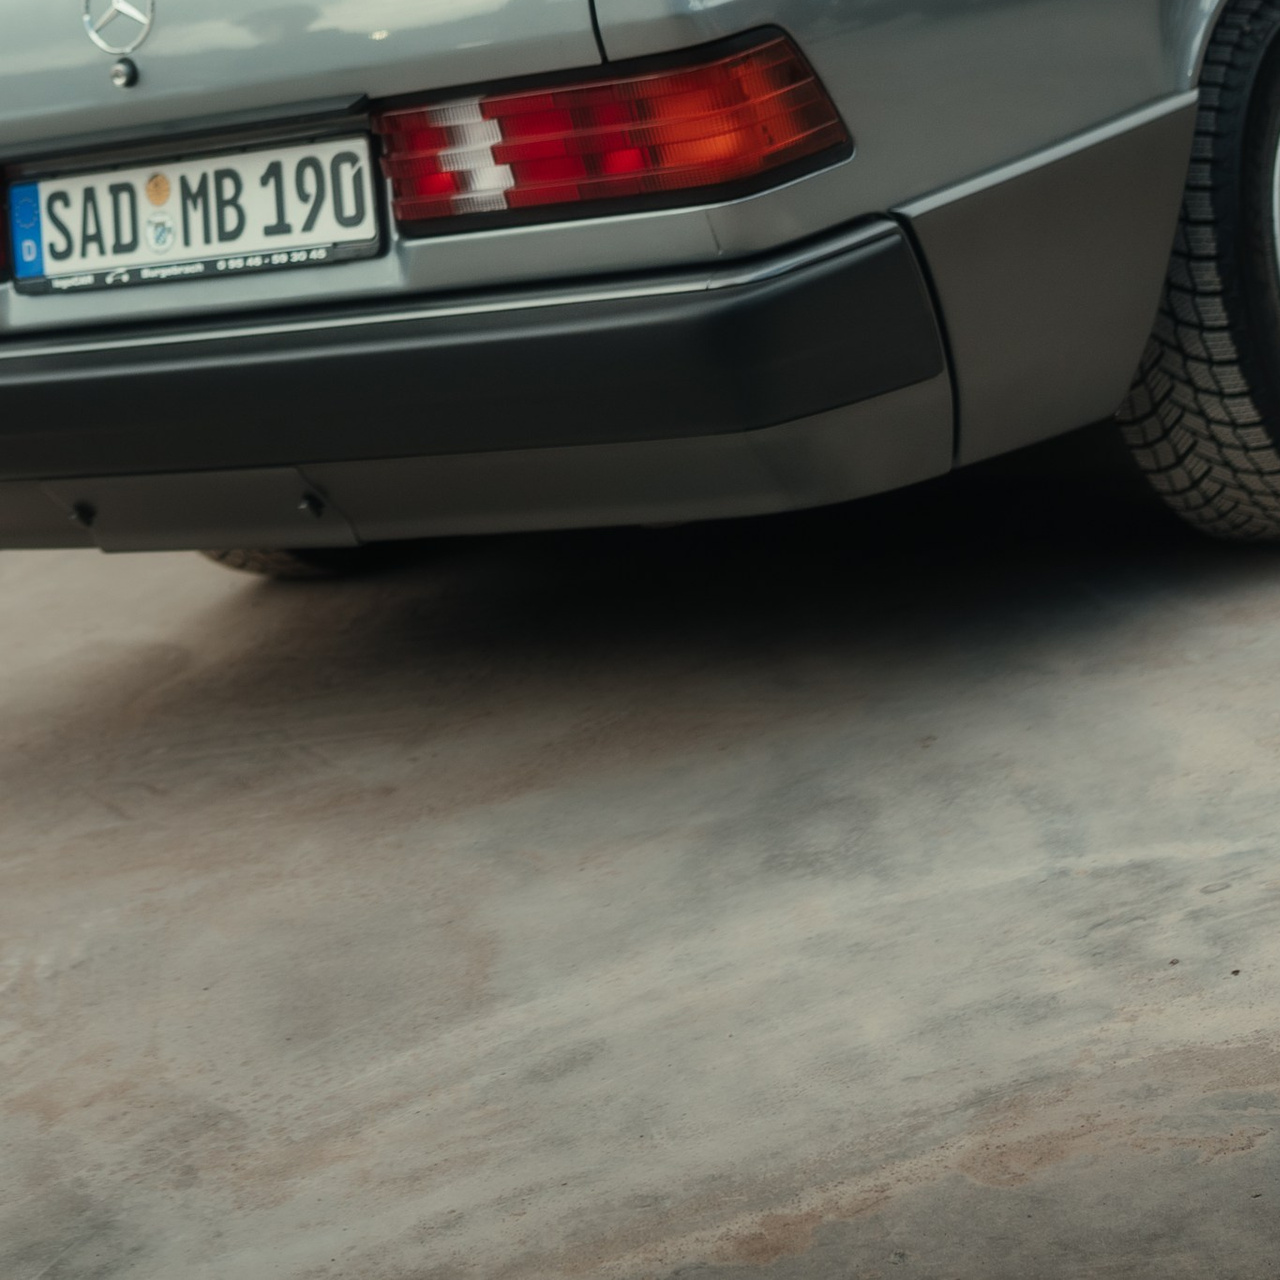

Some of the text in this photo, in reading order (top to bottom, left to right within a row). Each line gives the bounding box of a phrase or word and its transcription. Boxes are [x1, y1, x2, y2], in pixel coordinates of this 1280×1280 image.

[46, 151, 366, 261] SAD MB 190
[21, 239, 37, 262] D
